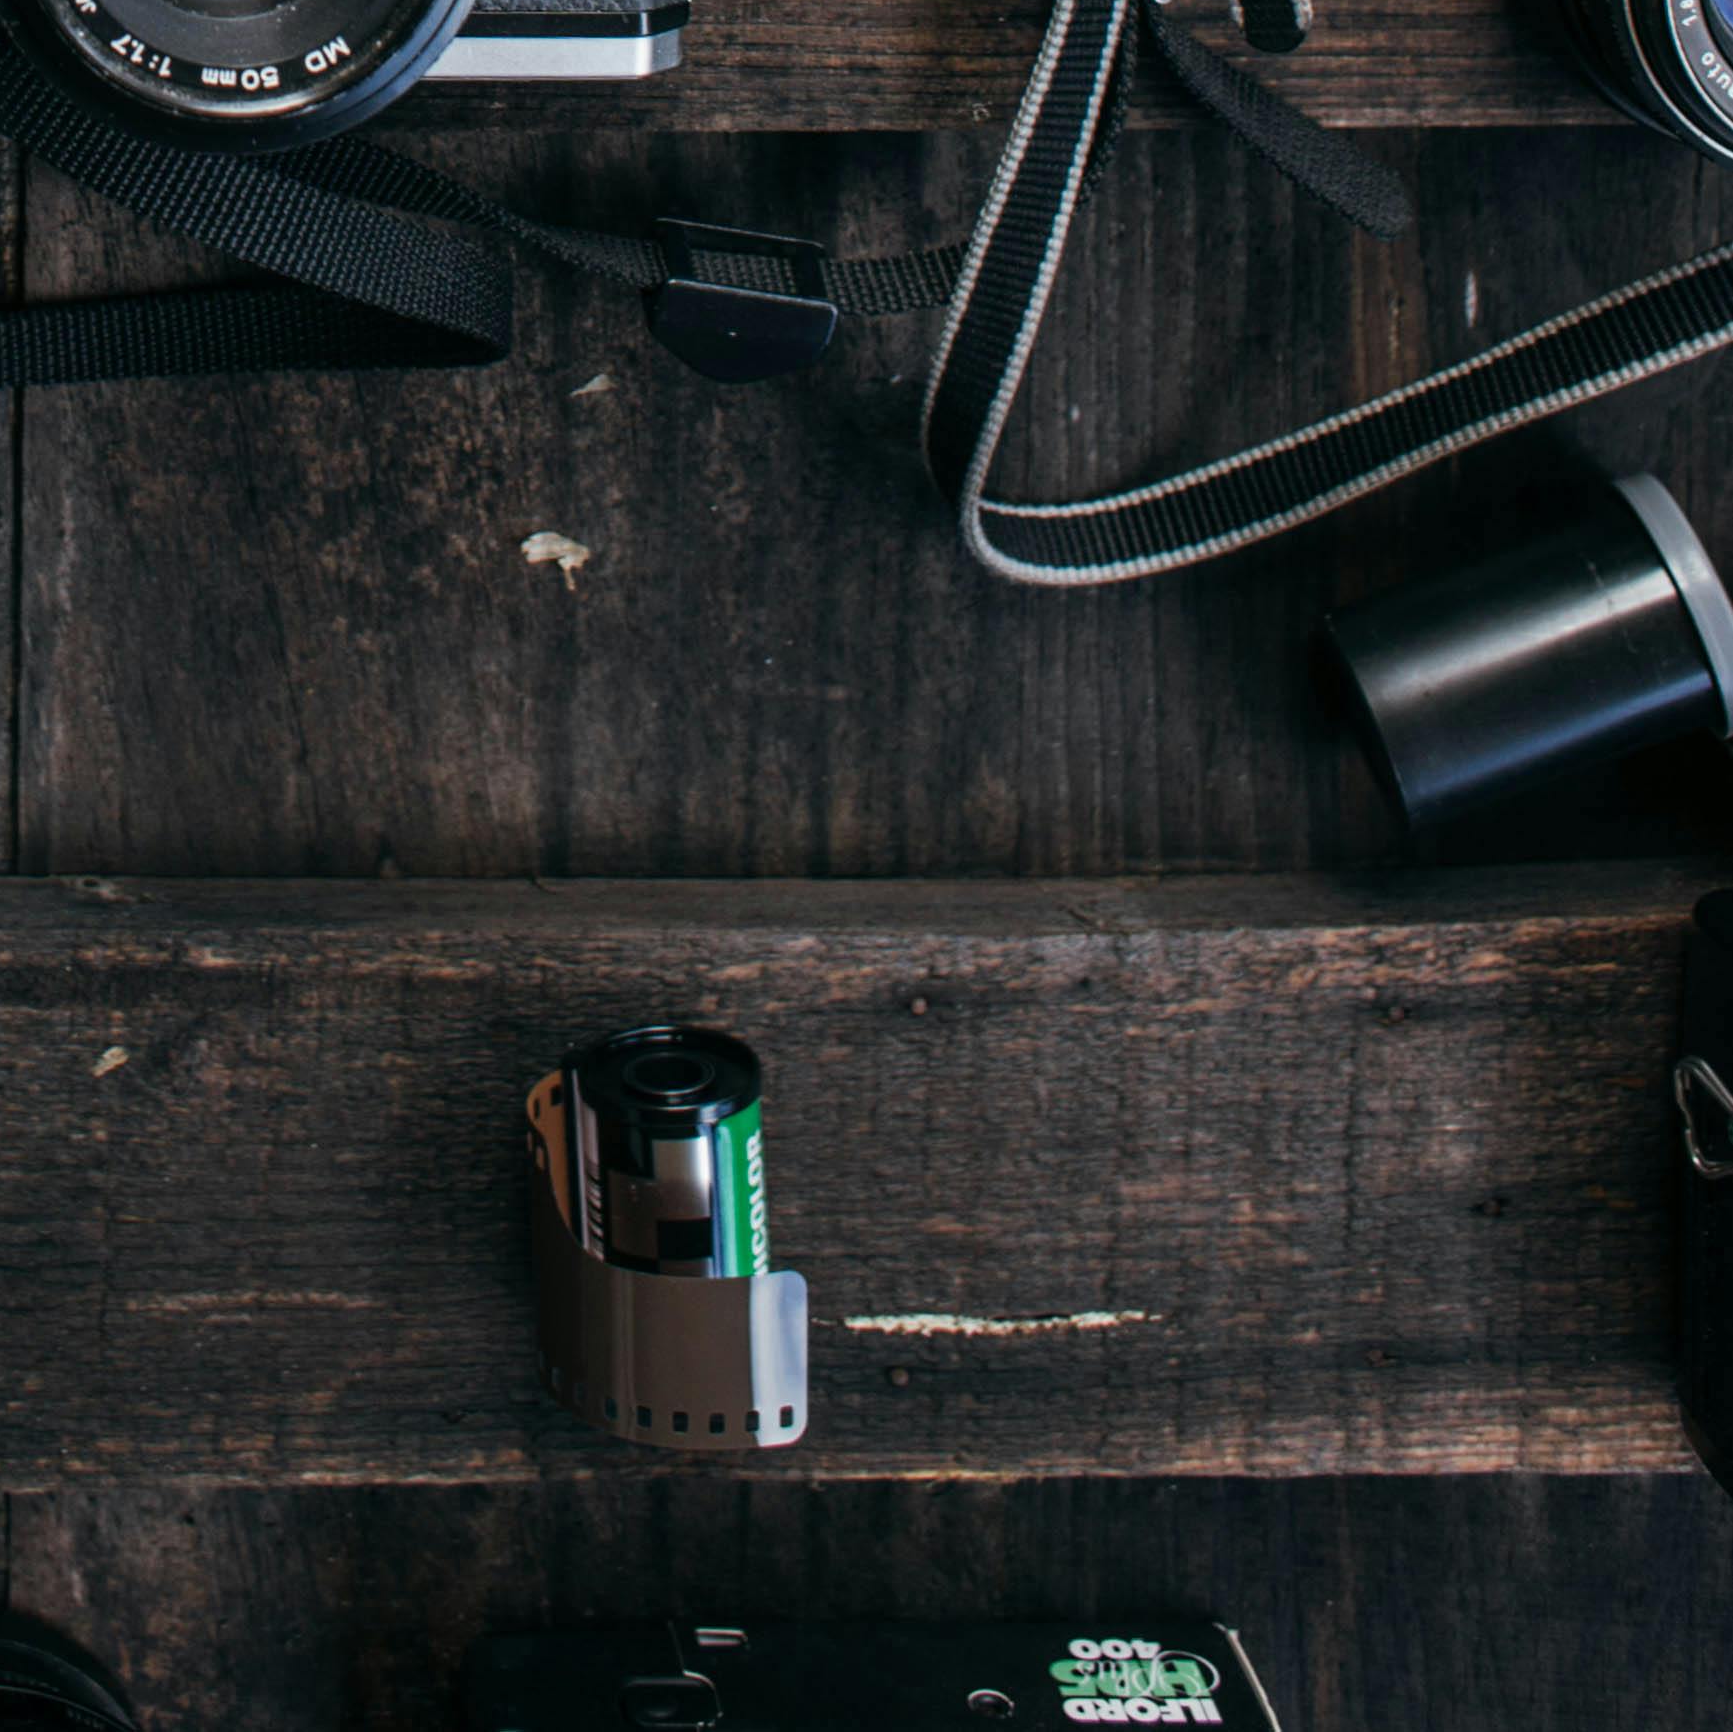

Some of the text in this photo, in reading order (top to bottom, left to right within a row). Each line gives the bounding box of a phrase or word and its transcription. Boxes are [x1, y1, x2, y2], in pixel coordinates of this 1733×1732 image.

[109, 32, 174, 79] 1:1.7
[304, 35, 353, 73] MD
[1068, 1637, 1162, 1660] 400
[1062, 1696, 1224, 1725] ILFORD
